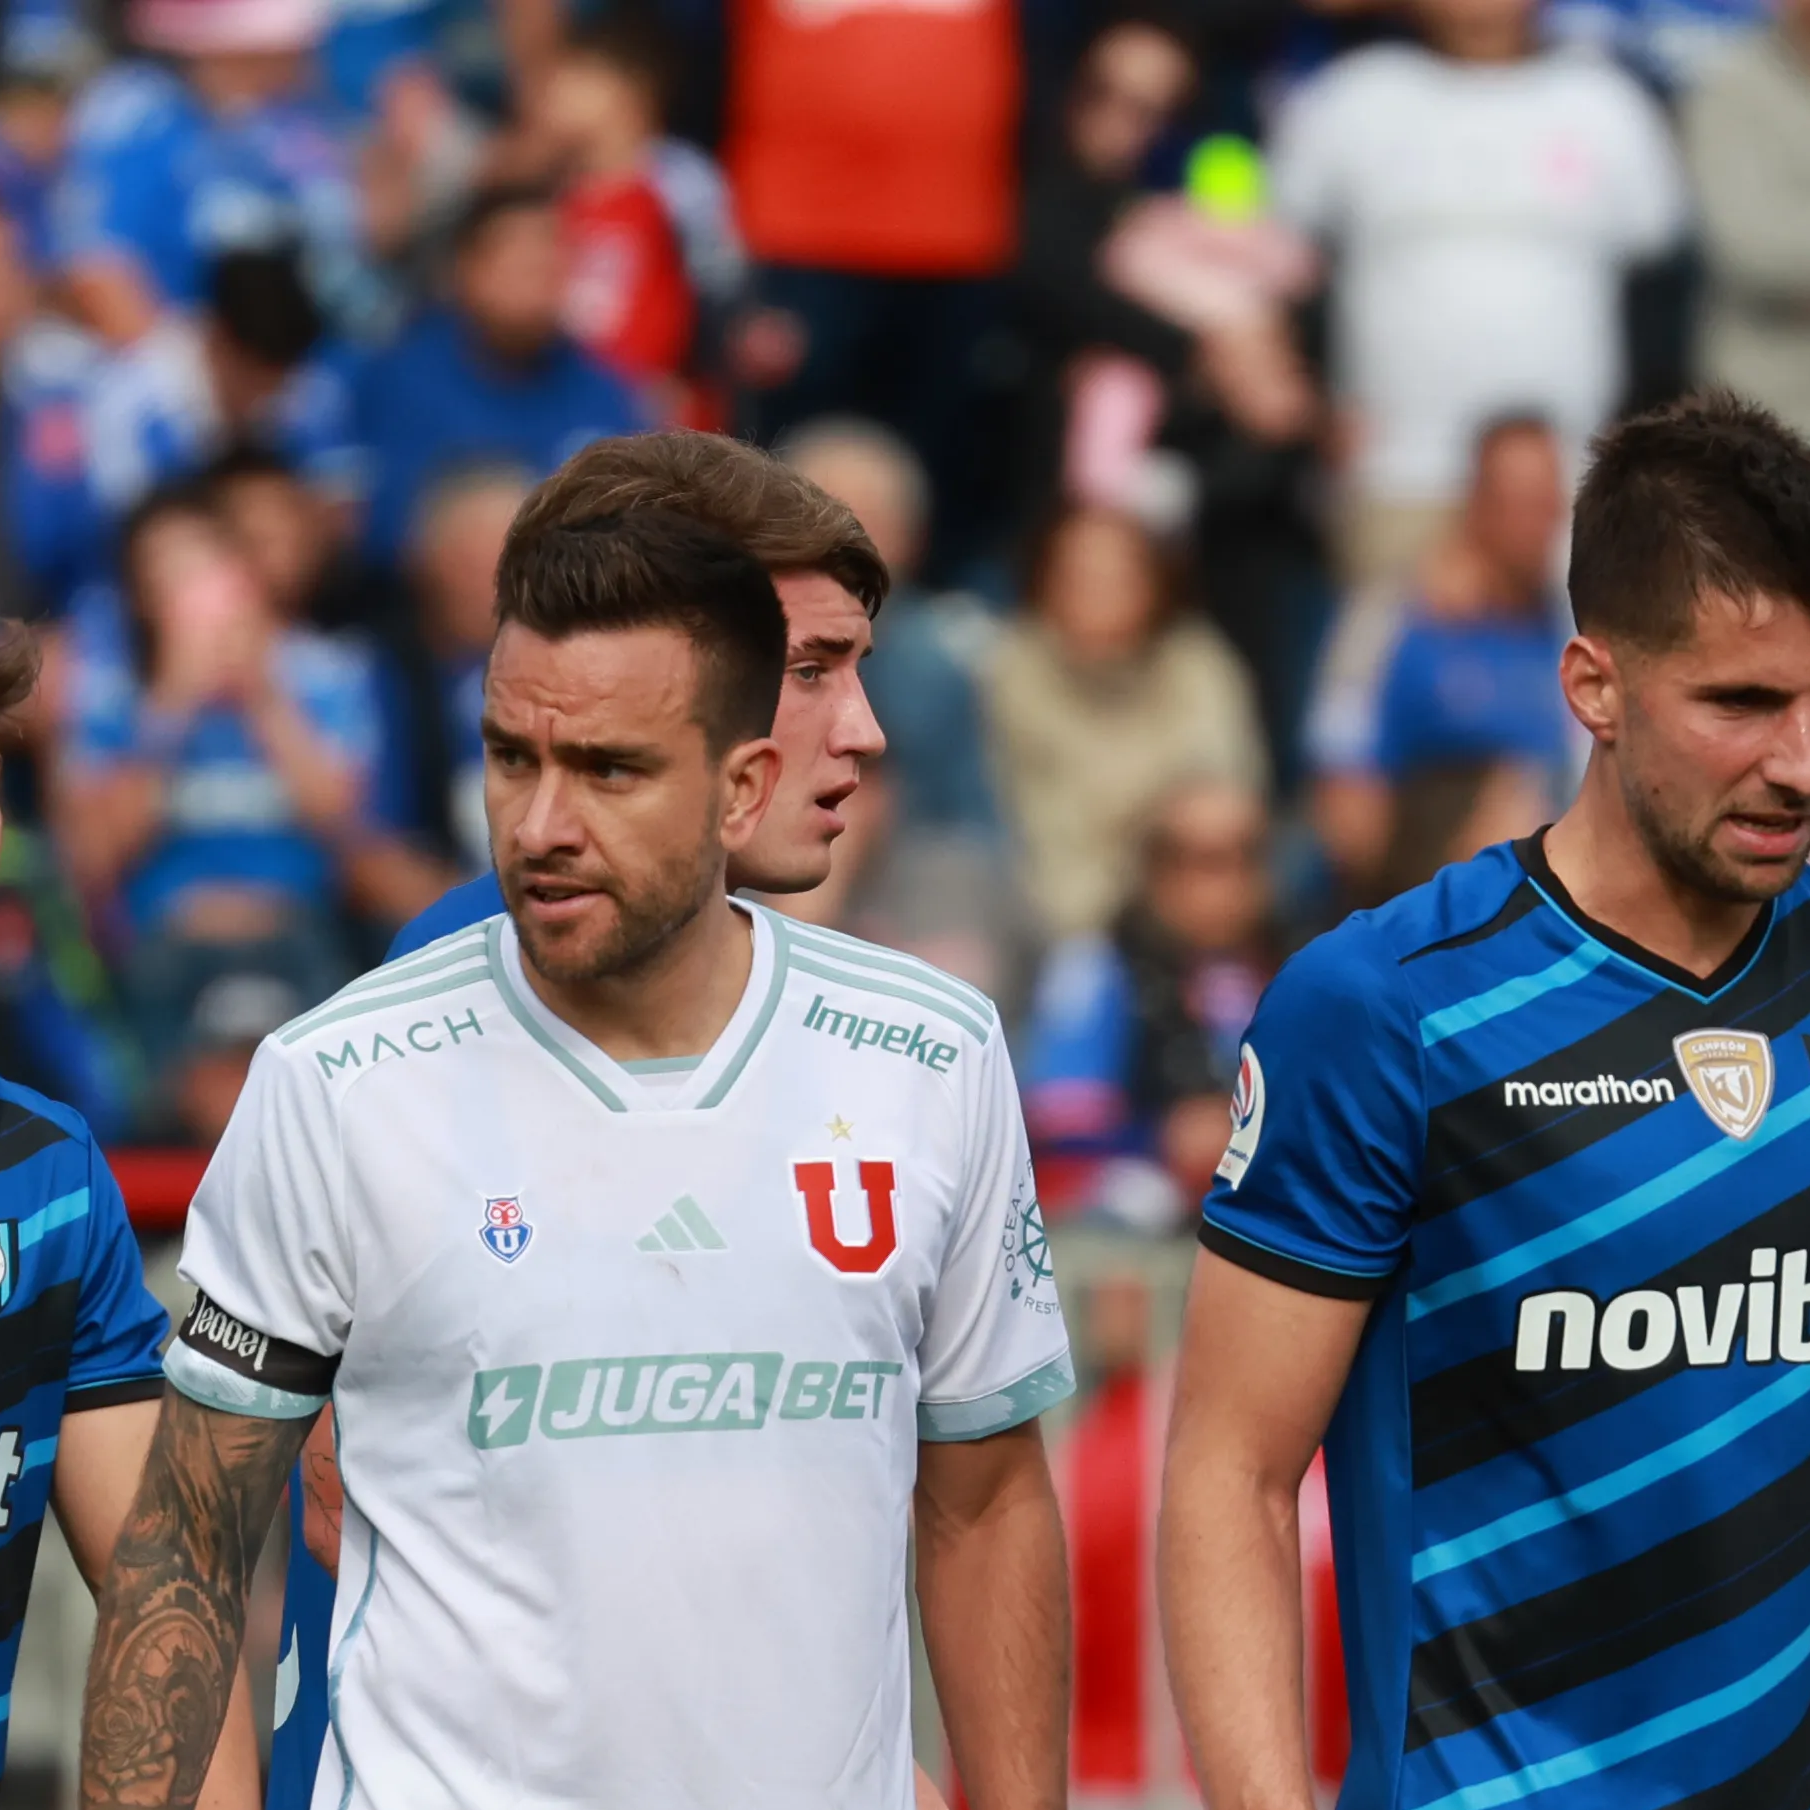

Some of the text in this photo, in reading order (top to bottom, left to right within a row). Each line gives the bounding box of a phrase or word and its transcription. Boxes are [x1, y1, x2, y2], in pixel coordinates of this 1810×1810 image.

[315, 1007, 484, 1080] MACH
[803, 995, 959, 1076] Impeke
[1505, 1075, 1675, 1107] marathon
[794, 1161, 897, 1273] U
